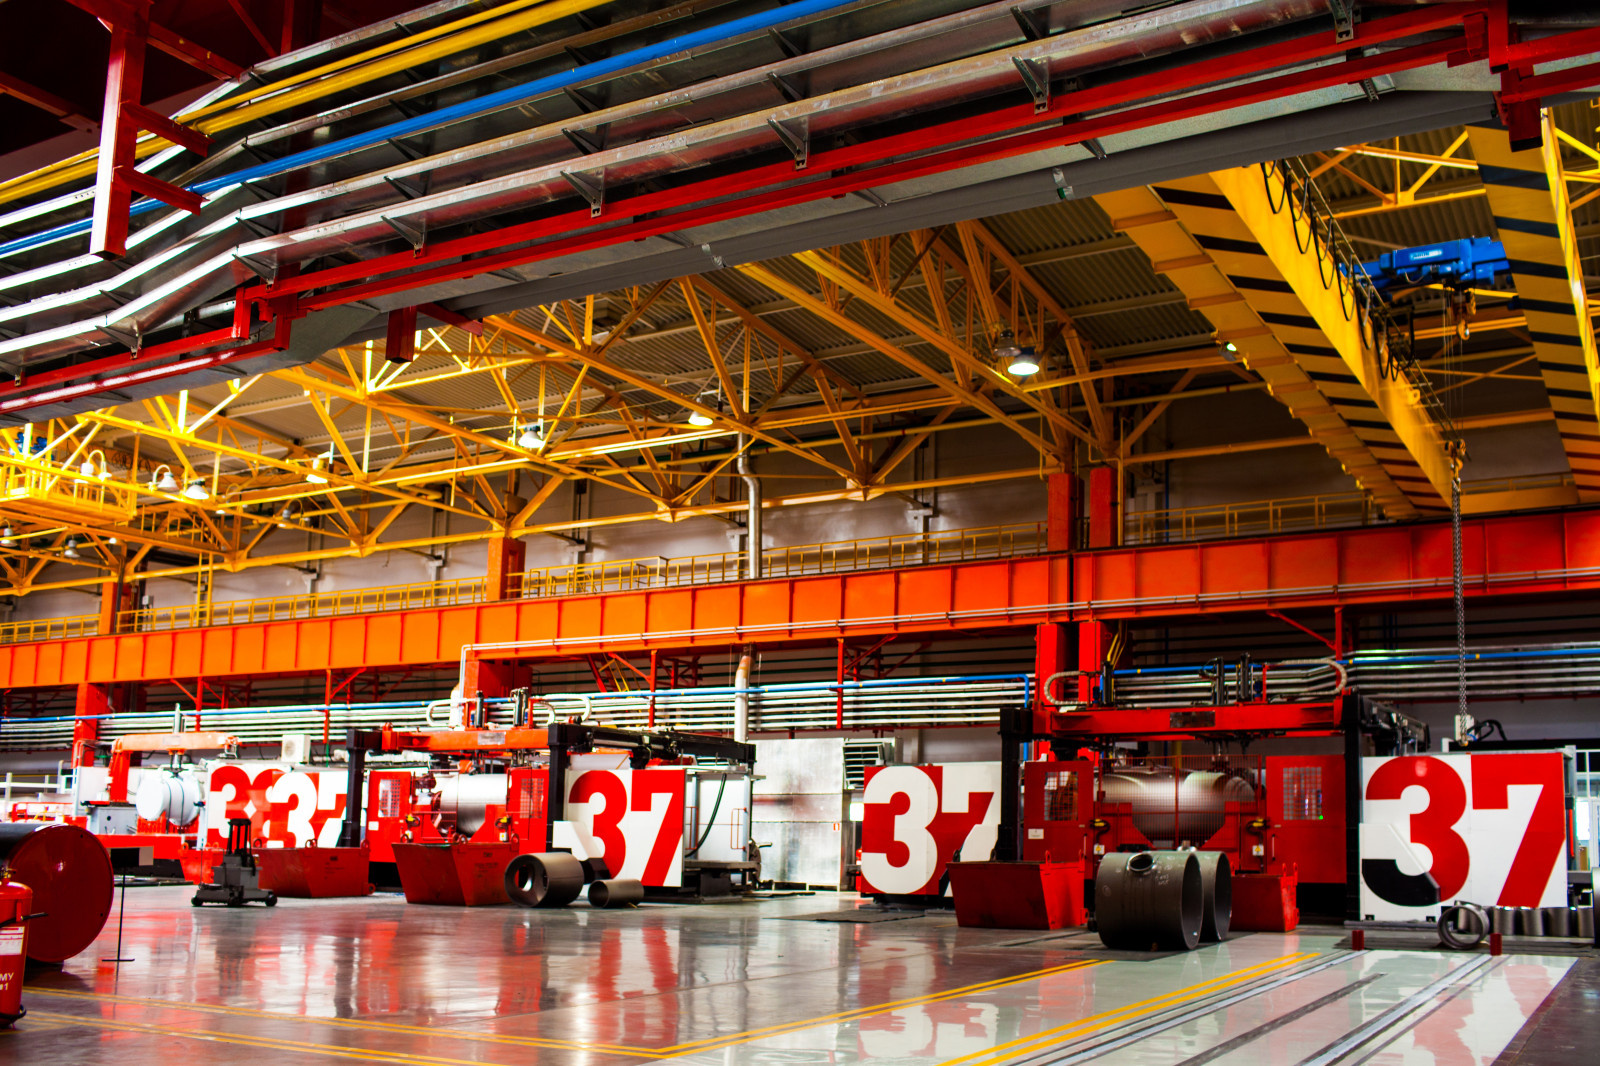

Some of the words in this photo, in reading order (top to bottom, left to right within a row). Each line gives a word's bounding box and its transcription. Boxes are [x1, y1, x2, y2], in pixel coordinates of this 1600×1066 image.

[267, 772, 348, 847] 37
[553, 770, 685, 886] 37
[861, 762, 1001, 897] 37
[1362, 754, 1566, 908] 37
